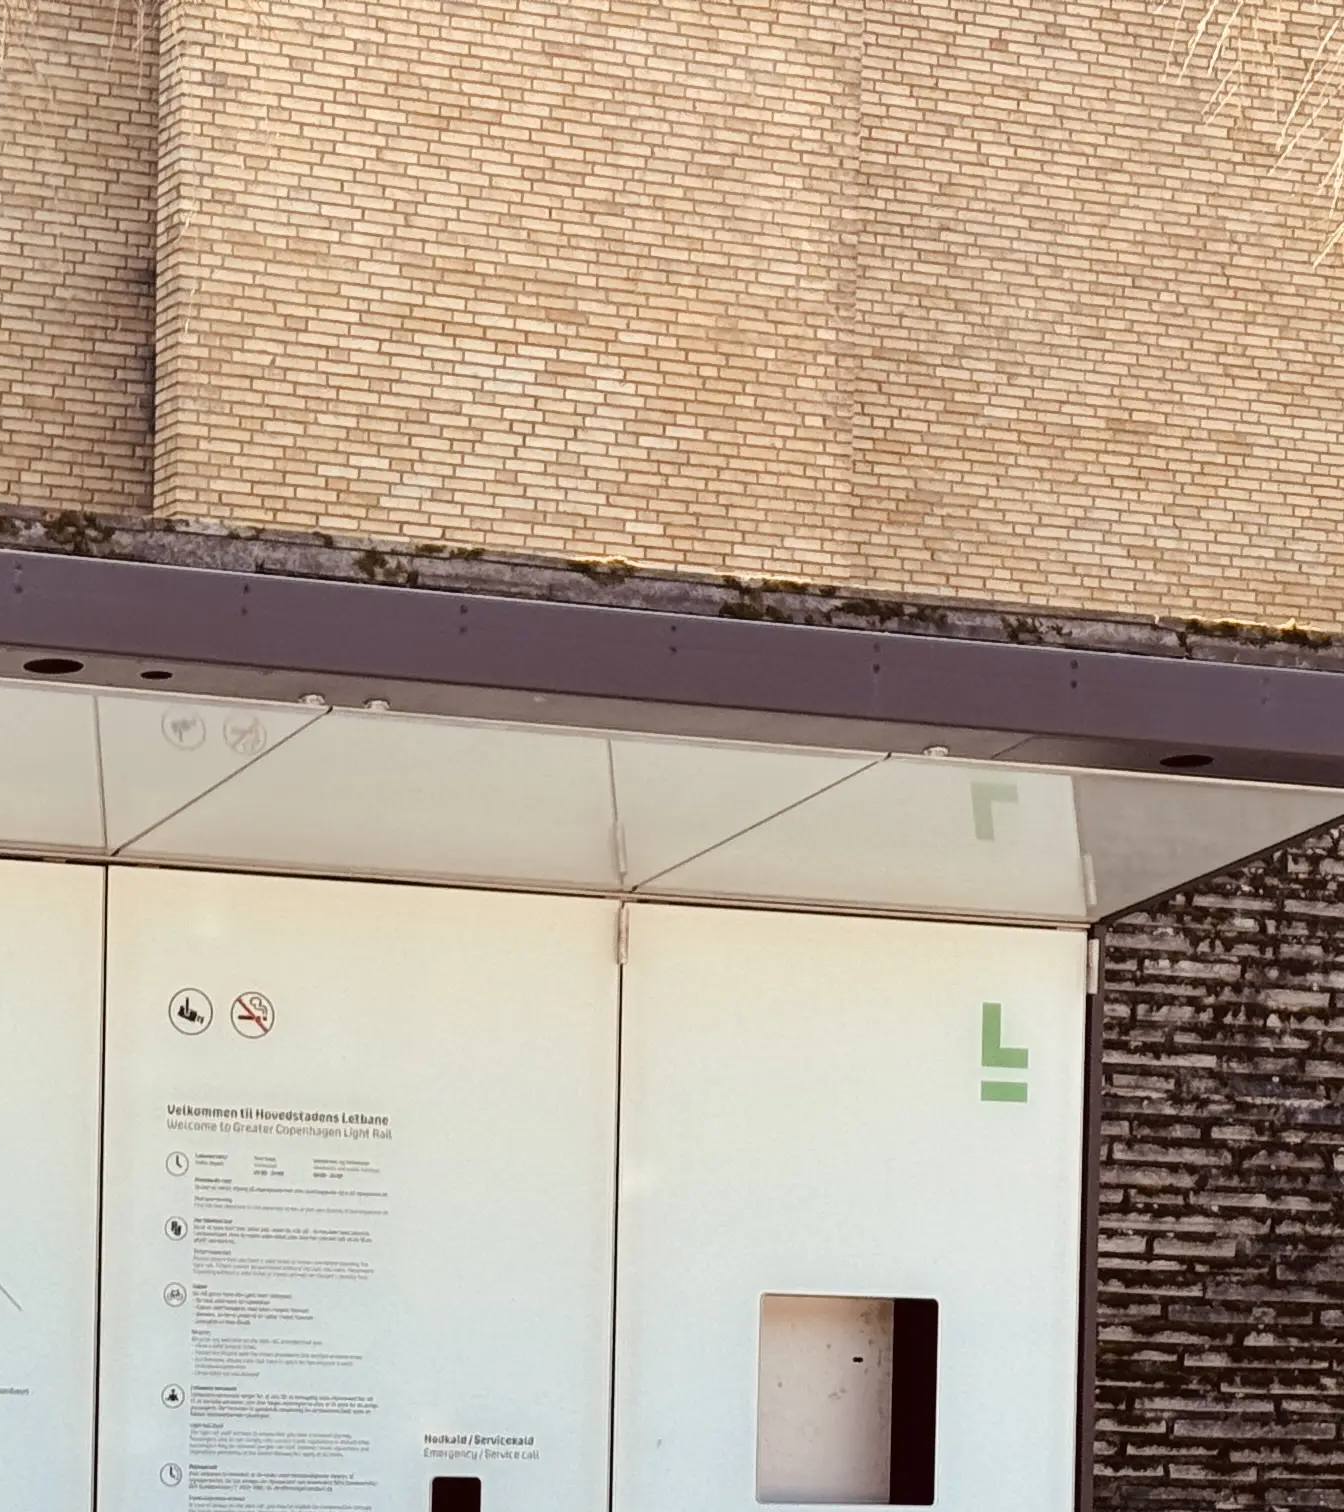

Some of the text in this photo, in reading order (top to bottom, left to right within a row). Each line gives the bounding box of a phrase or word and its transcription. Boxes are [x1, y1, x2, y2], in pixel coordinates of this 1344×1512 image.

[166, 1103, 389, 1126] Velkommen til Hovedstadens Letbane
[166, 1118, 393, 1140] Welcome to Greater Copenhagen Light Rail
